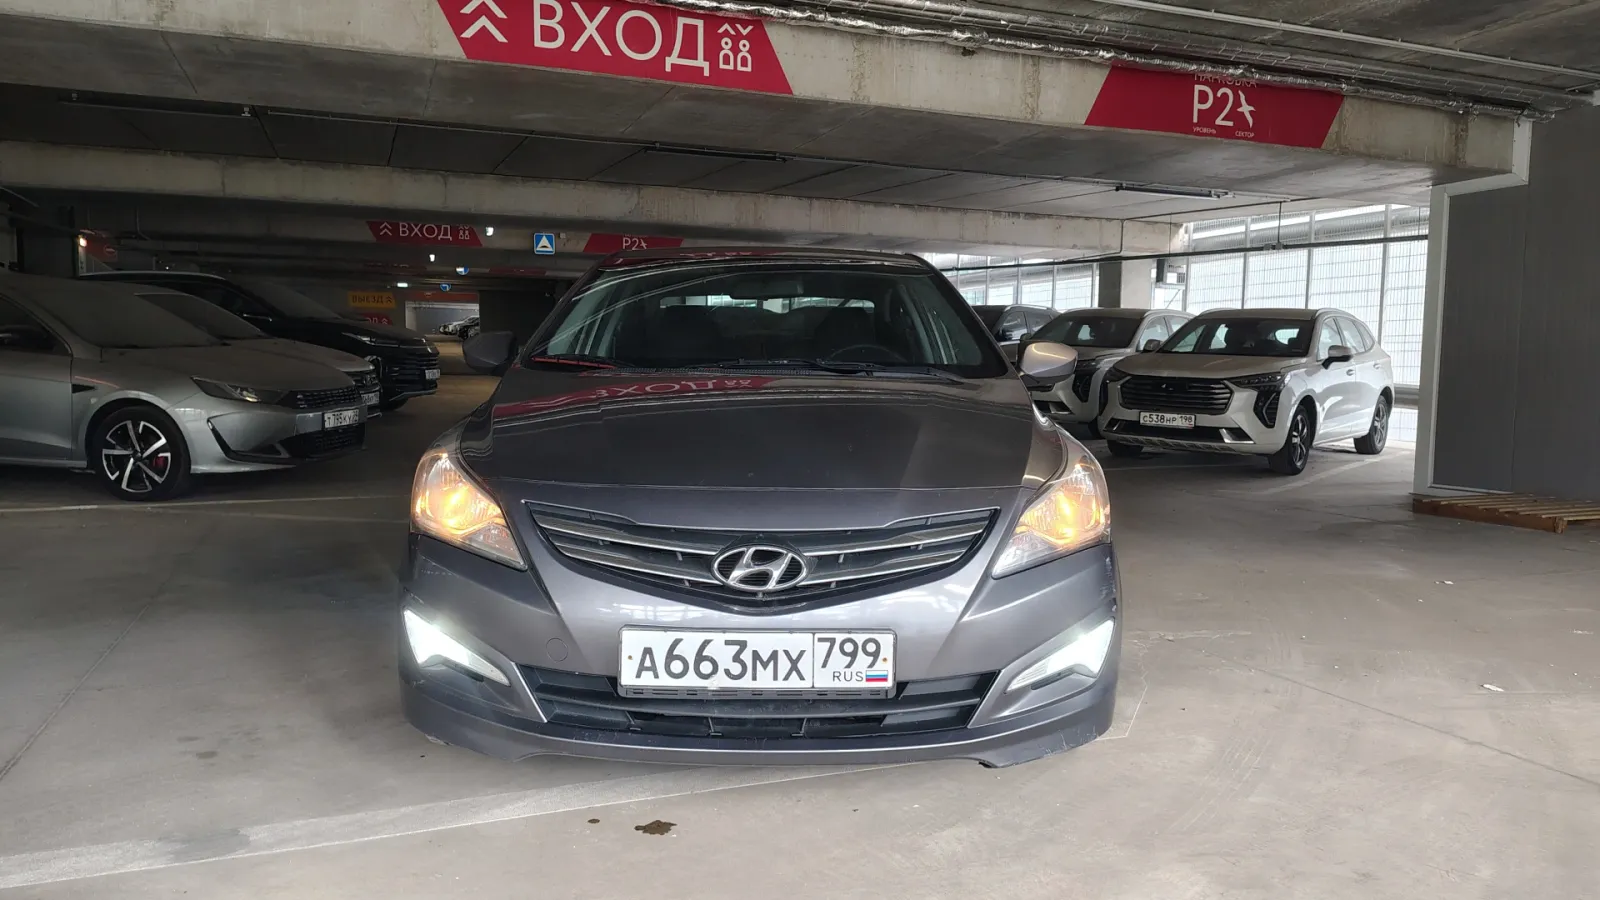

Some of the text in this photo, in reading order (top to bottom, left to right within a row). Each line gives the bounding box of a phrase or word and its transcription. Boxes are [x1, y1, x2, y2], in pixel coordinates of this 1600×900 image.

[533, 0, 710, 77] ВХОД
[399, 222, 453, 241] ВХОД
[635, 637, 881, 682] А663МХ 799
[832, 671, 864, 682] RUS
